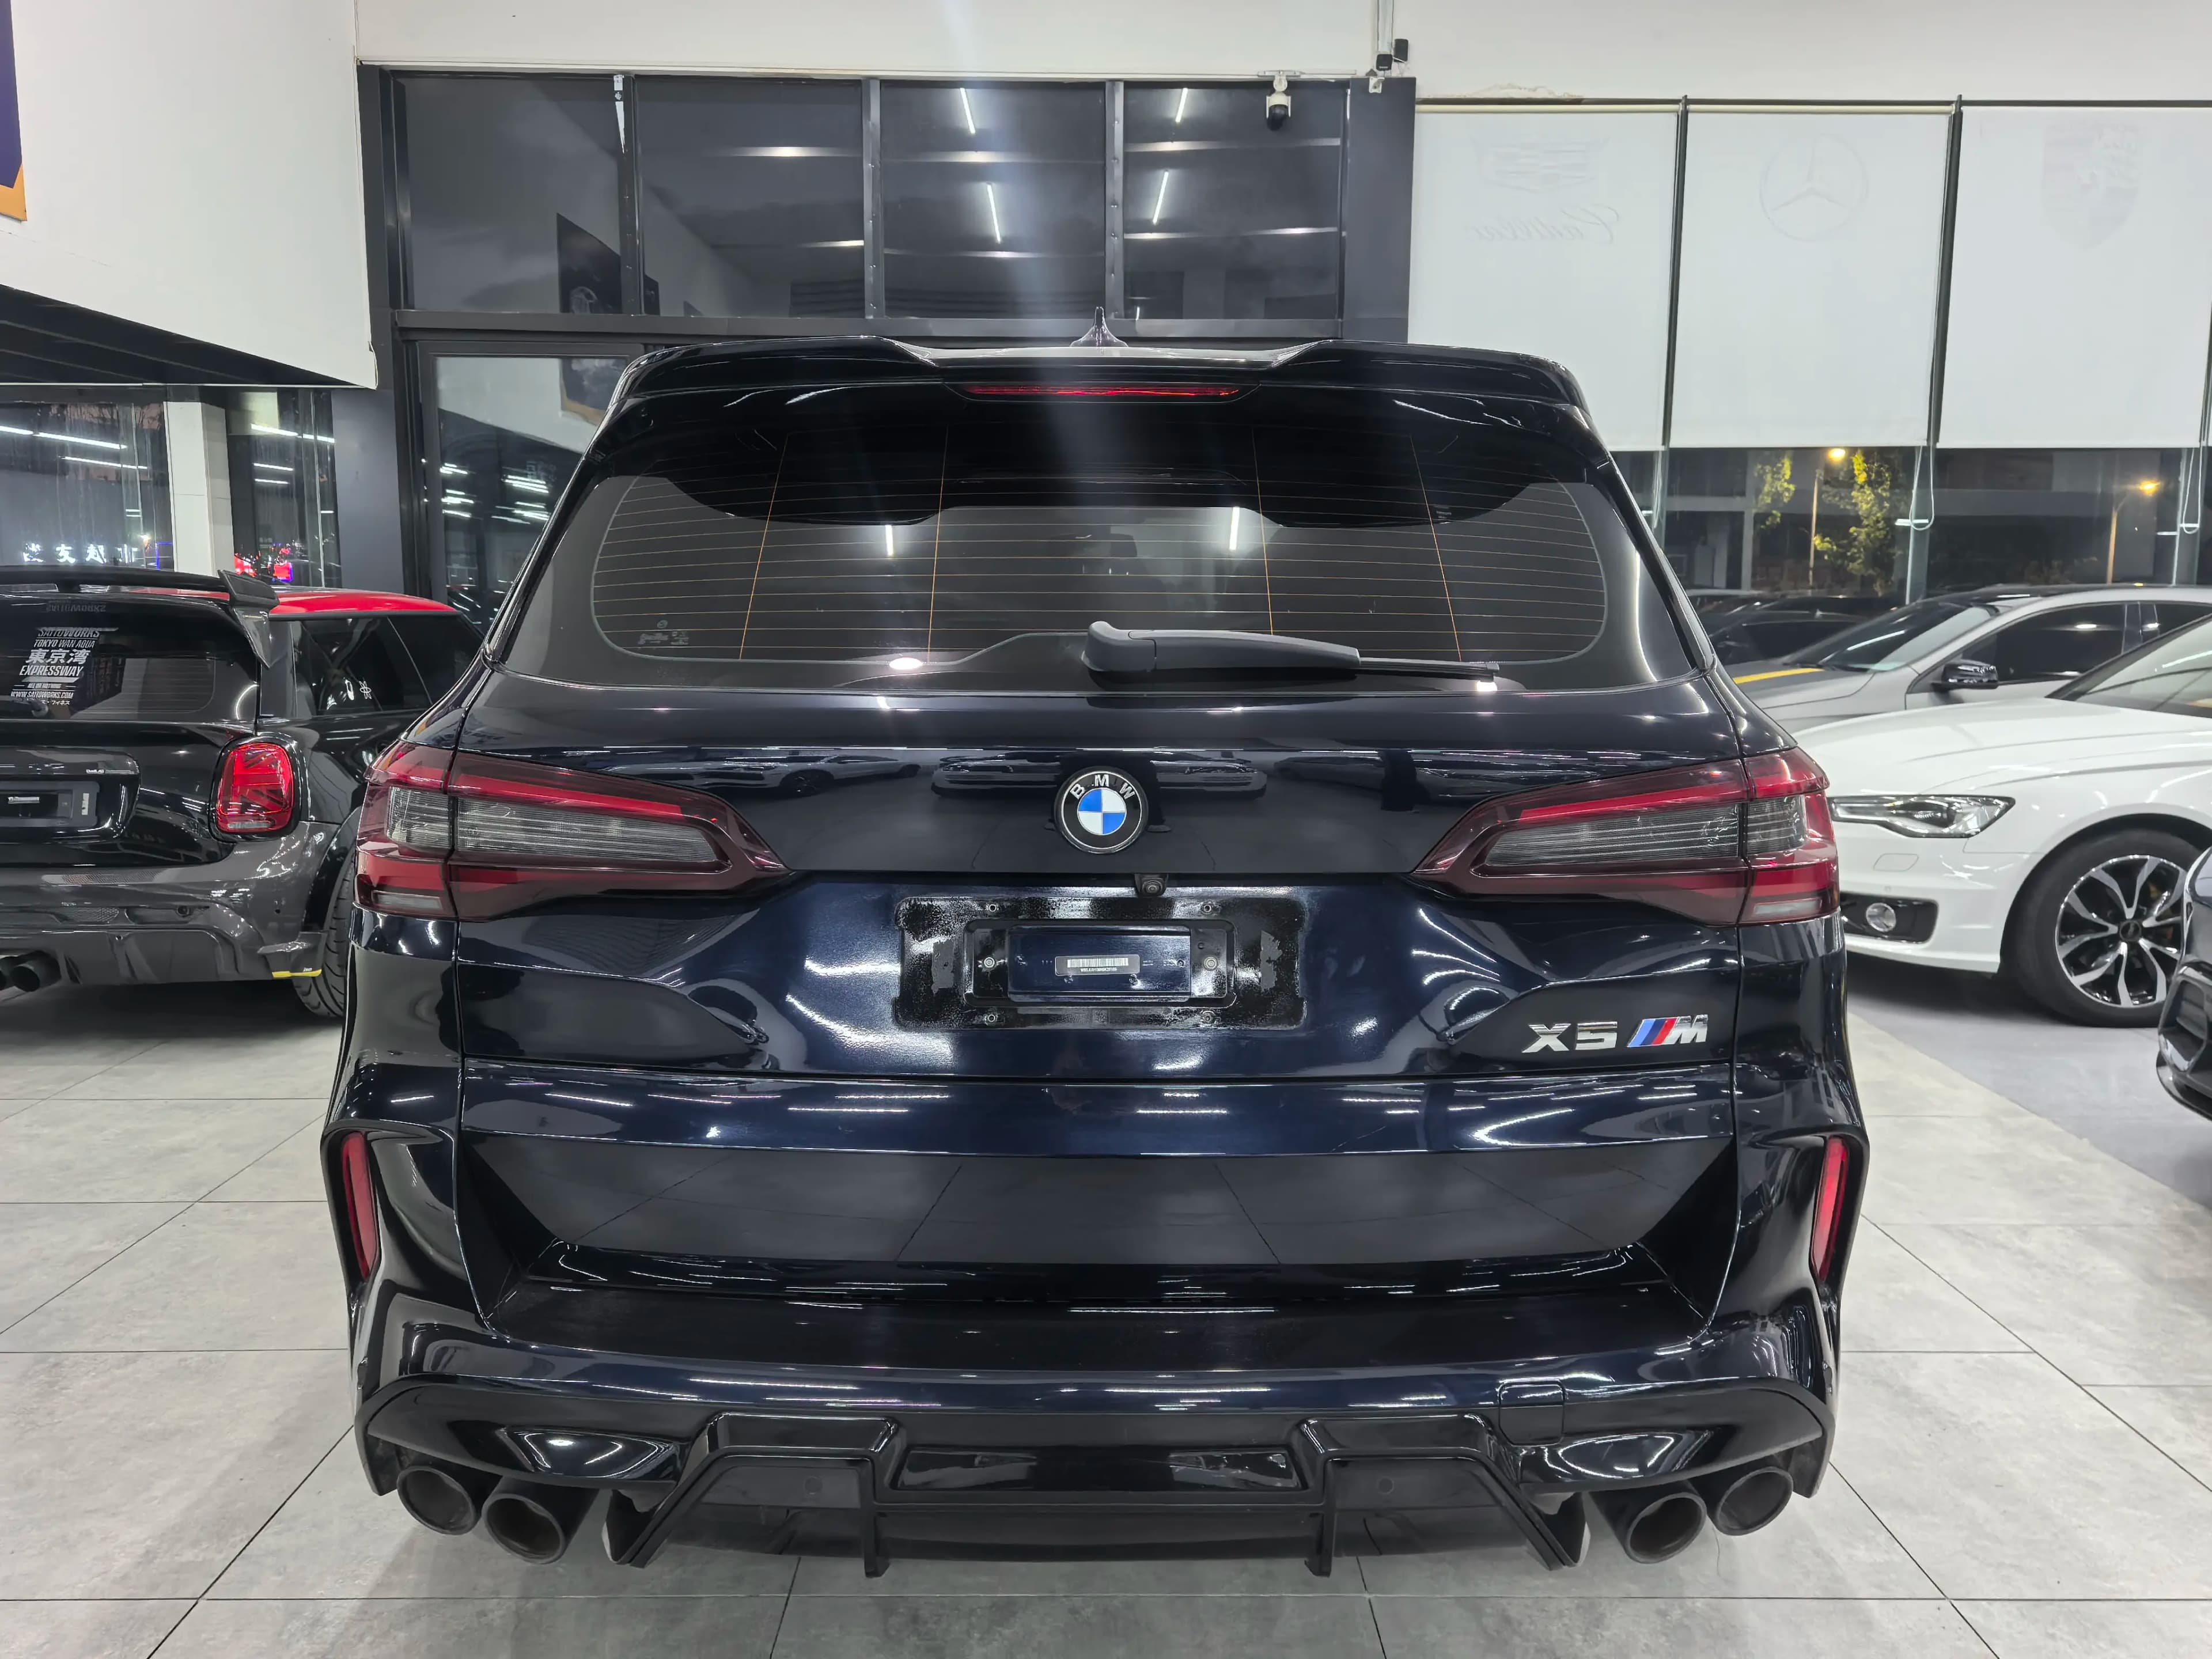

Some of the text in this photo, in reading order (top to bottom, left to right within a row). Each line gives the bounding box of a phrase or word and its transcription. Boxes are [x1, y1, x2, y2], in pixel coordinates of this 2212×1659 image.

[37, 627, 101, 638] SAITOWORKS
[33, 639, 58, 647] TOKYO
[58, 639, 75, 648] WAN
[25, 648, 91, 665] 東京湾
[19, 665, 85, 676] EXPRESSWAY
[1070, 774, 1135, 800] BMW
[1522, 1014, 1709, 1053] X5 M
